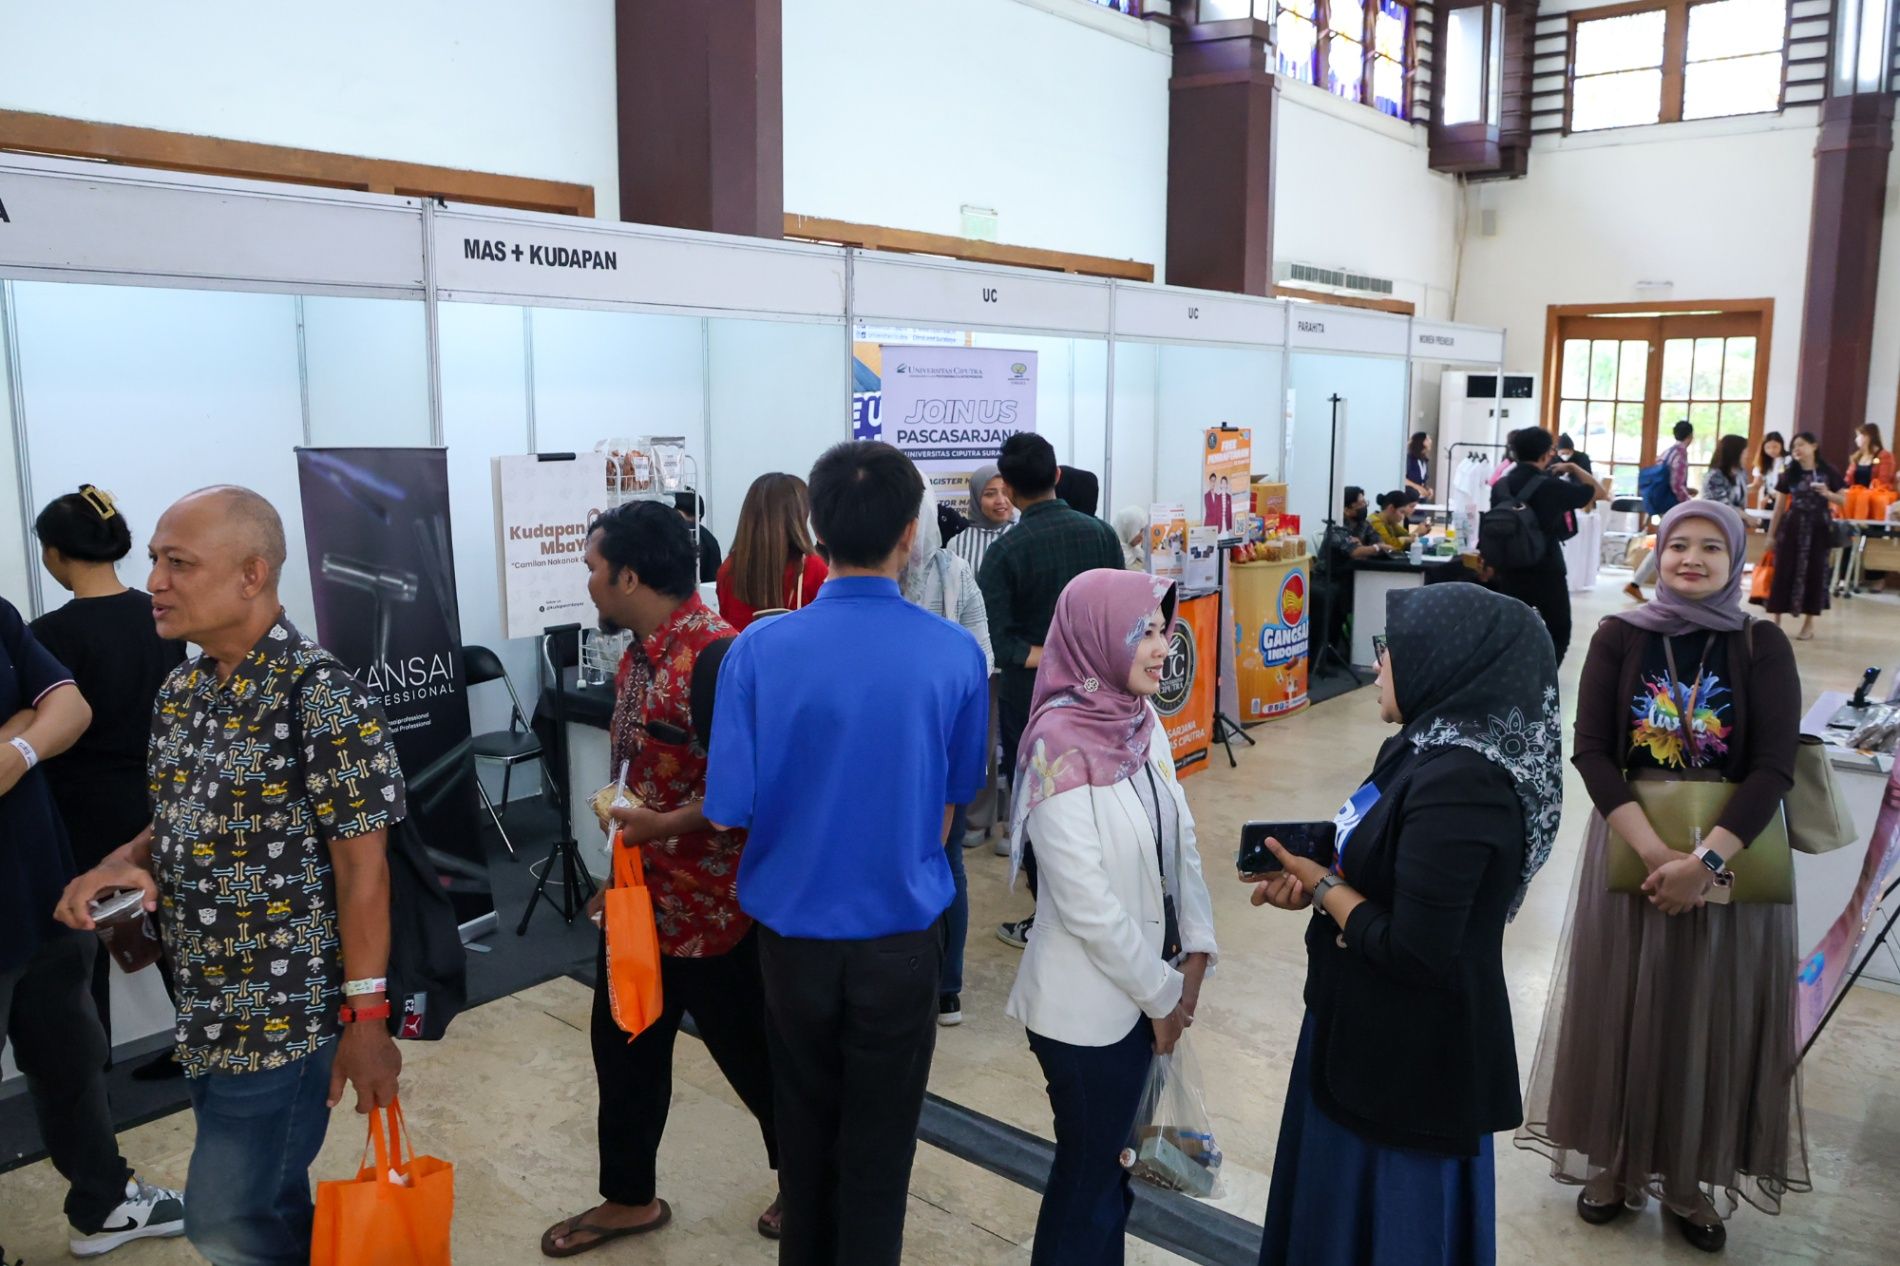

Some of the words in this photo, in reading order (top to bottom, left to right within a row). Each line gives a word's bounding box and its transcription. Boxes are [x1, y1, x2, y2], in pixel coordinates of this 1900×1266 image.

[464, 238, 507, 262] MAS
[529, 244, 618, 270] KUDAPAN
[982, 288, 998, 303] UC
[1188, 307, 1200, 320] UC
[1298, 321, 1325, 334] PARAHITA
[904, 400, 976, 424] JOIN
[977, 400, 1018, 424] US
[982, 449, 1003, 457] SURA
[509, 524, 586, 543] Kudapan
[540, 536, 588, 555] MbaY
[354, 651, 454, 692] ANSAI
[379, 683, 455, 706] ESSIONAL
[1648, 704, 1707, 733] livn
[405, 999, 415, 1012] 23
